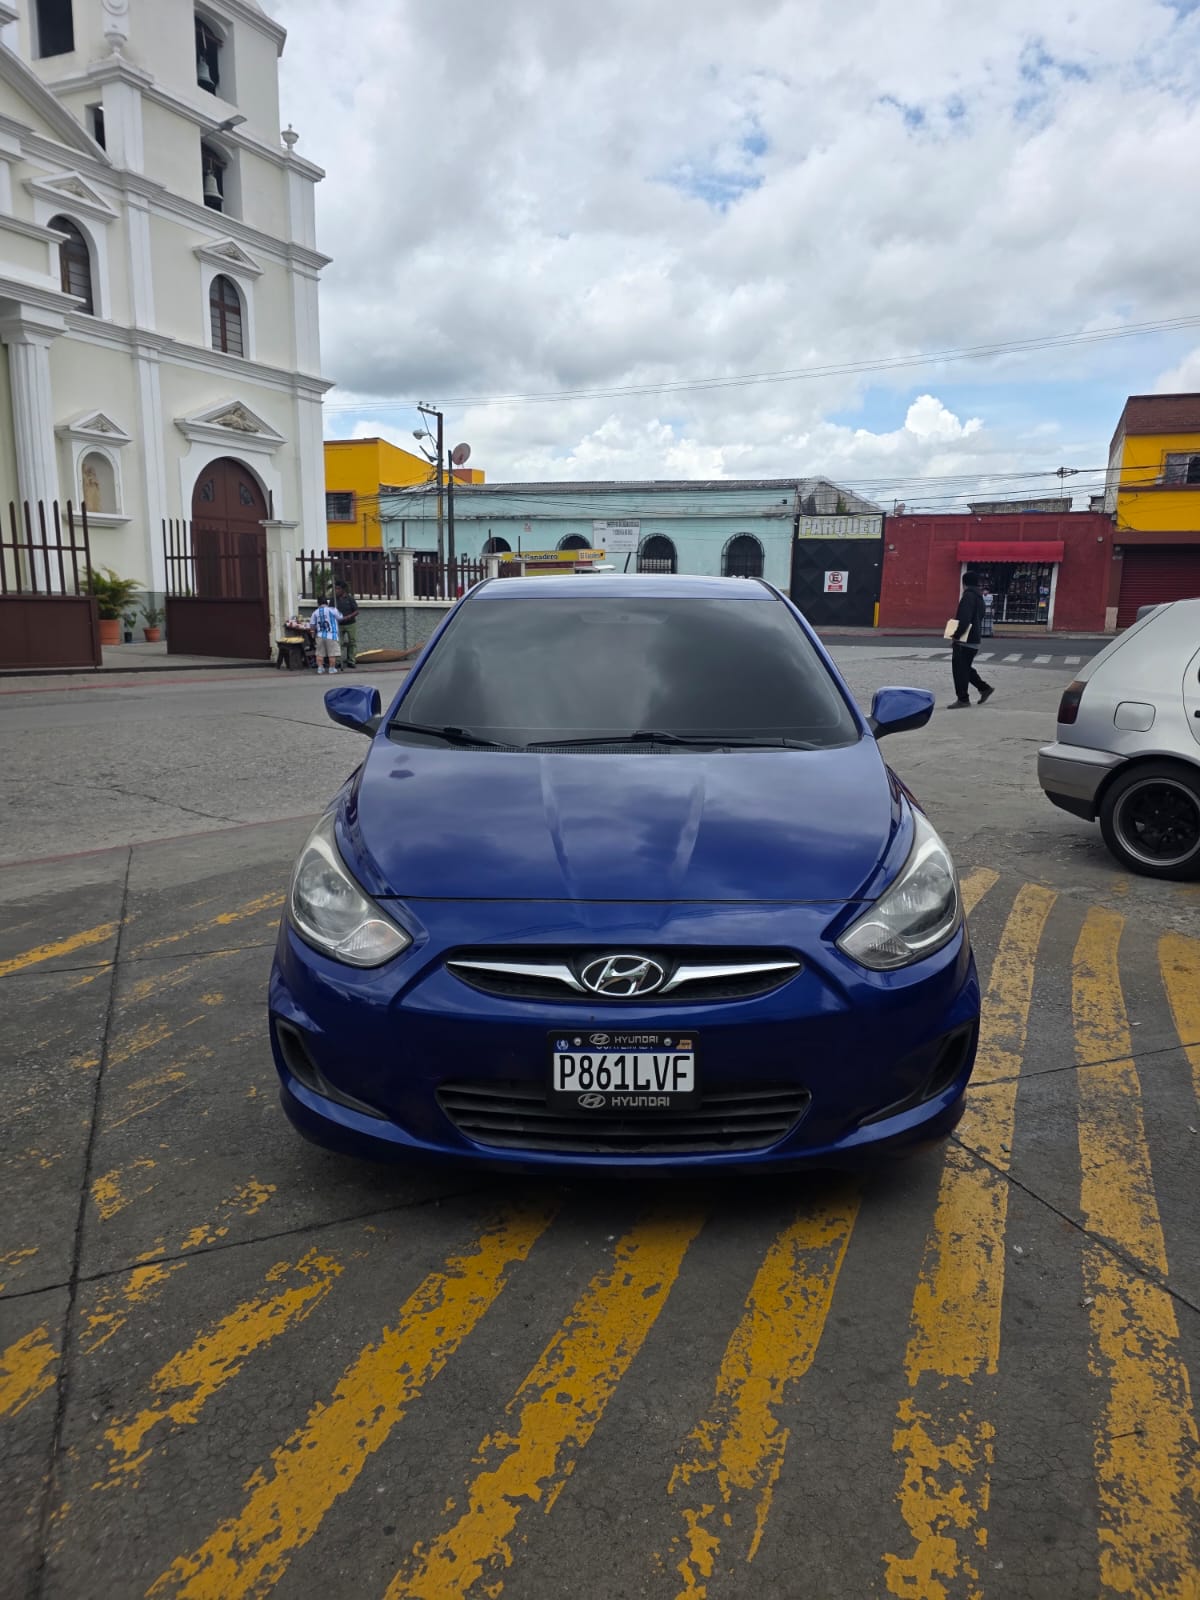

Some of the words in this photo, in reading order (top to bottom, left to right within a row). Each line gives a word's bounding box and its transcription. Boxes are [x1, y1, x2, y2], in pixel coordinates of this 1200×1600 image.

[801, 517, 881, 537] PARQUEO
[614, 1035, 659, 1044] HYUNDAI
[559, 1055, 691, 1091] P861LVF
[612, 1096, 670, 1107] HYUNDAI
